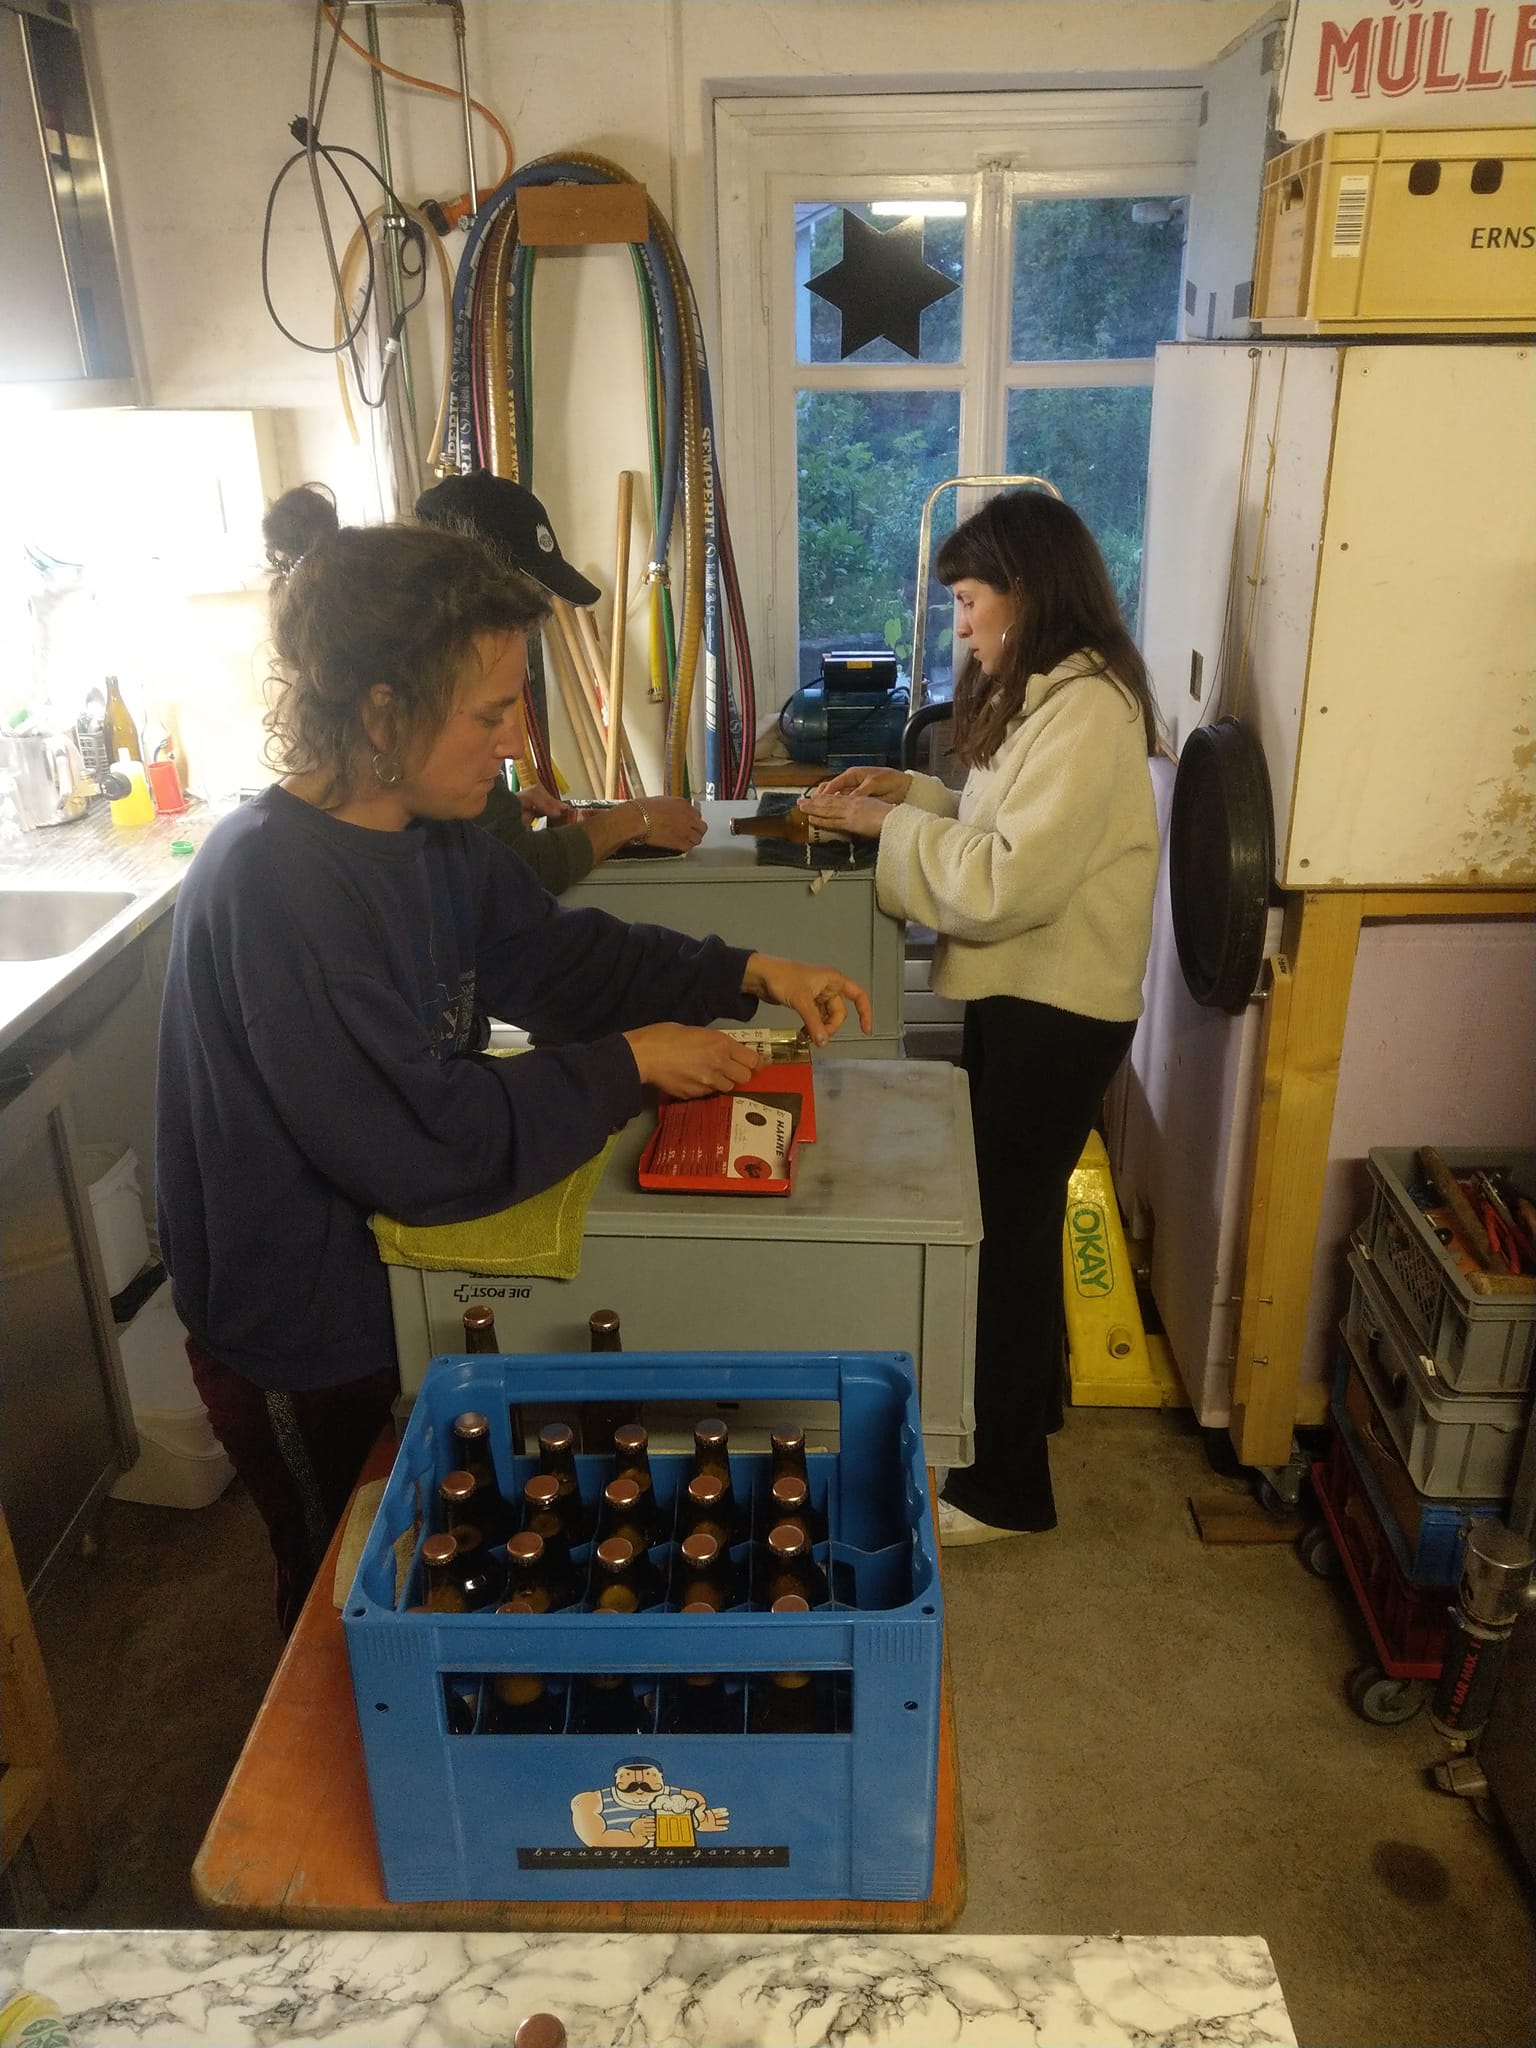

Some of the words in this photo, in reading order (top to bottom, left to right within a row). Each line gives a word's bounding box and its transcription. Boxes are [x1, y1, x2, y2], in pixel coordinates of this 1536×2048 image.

[1072, 1208, 1110, 1290] OKAY
[470, 1287, 506, 1298] POST
[508, 1288, 530, 1298] DIE
[649, 1847, 676, 1857] du
[692, 1847, 778, 1860] garage
